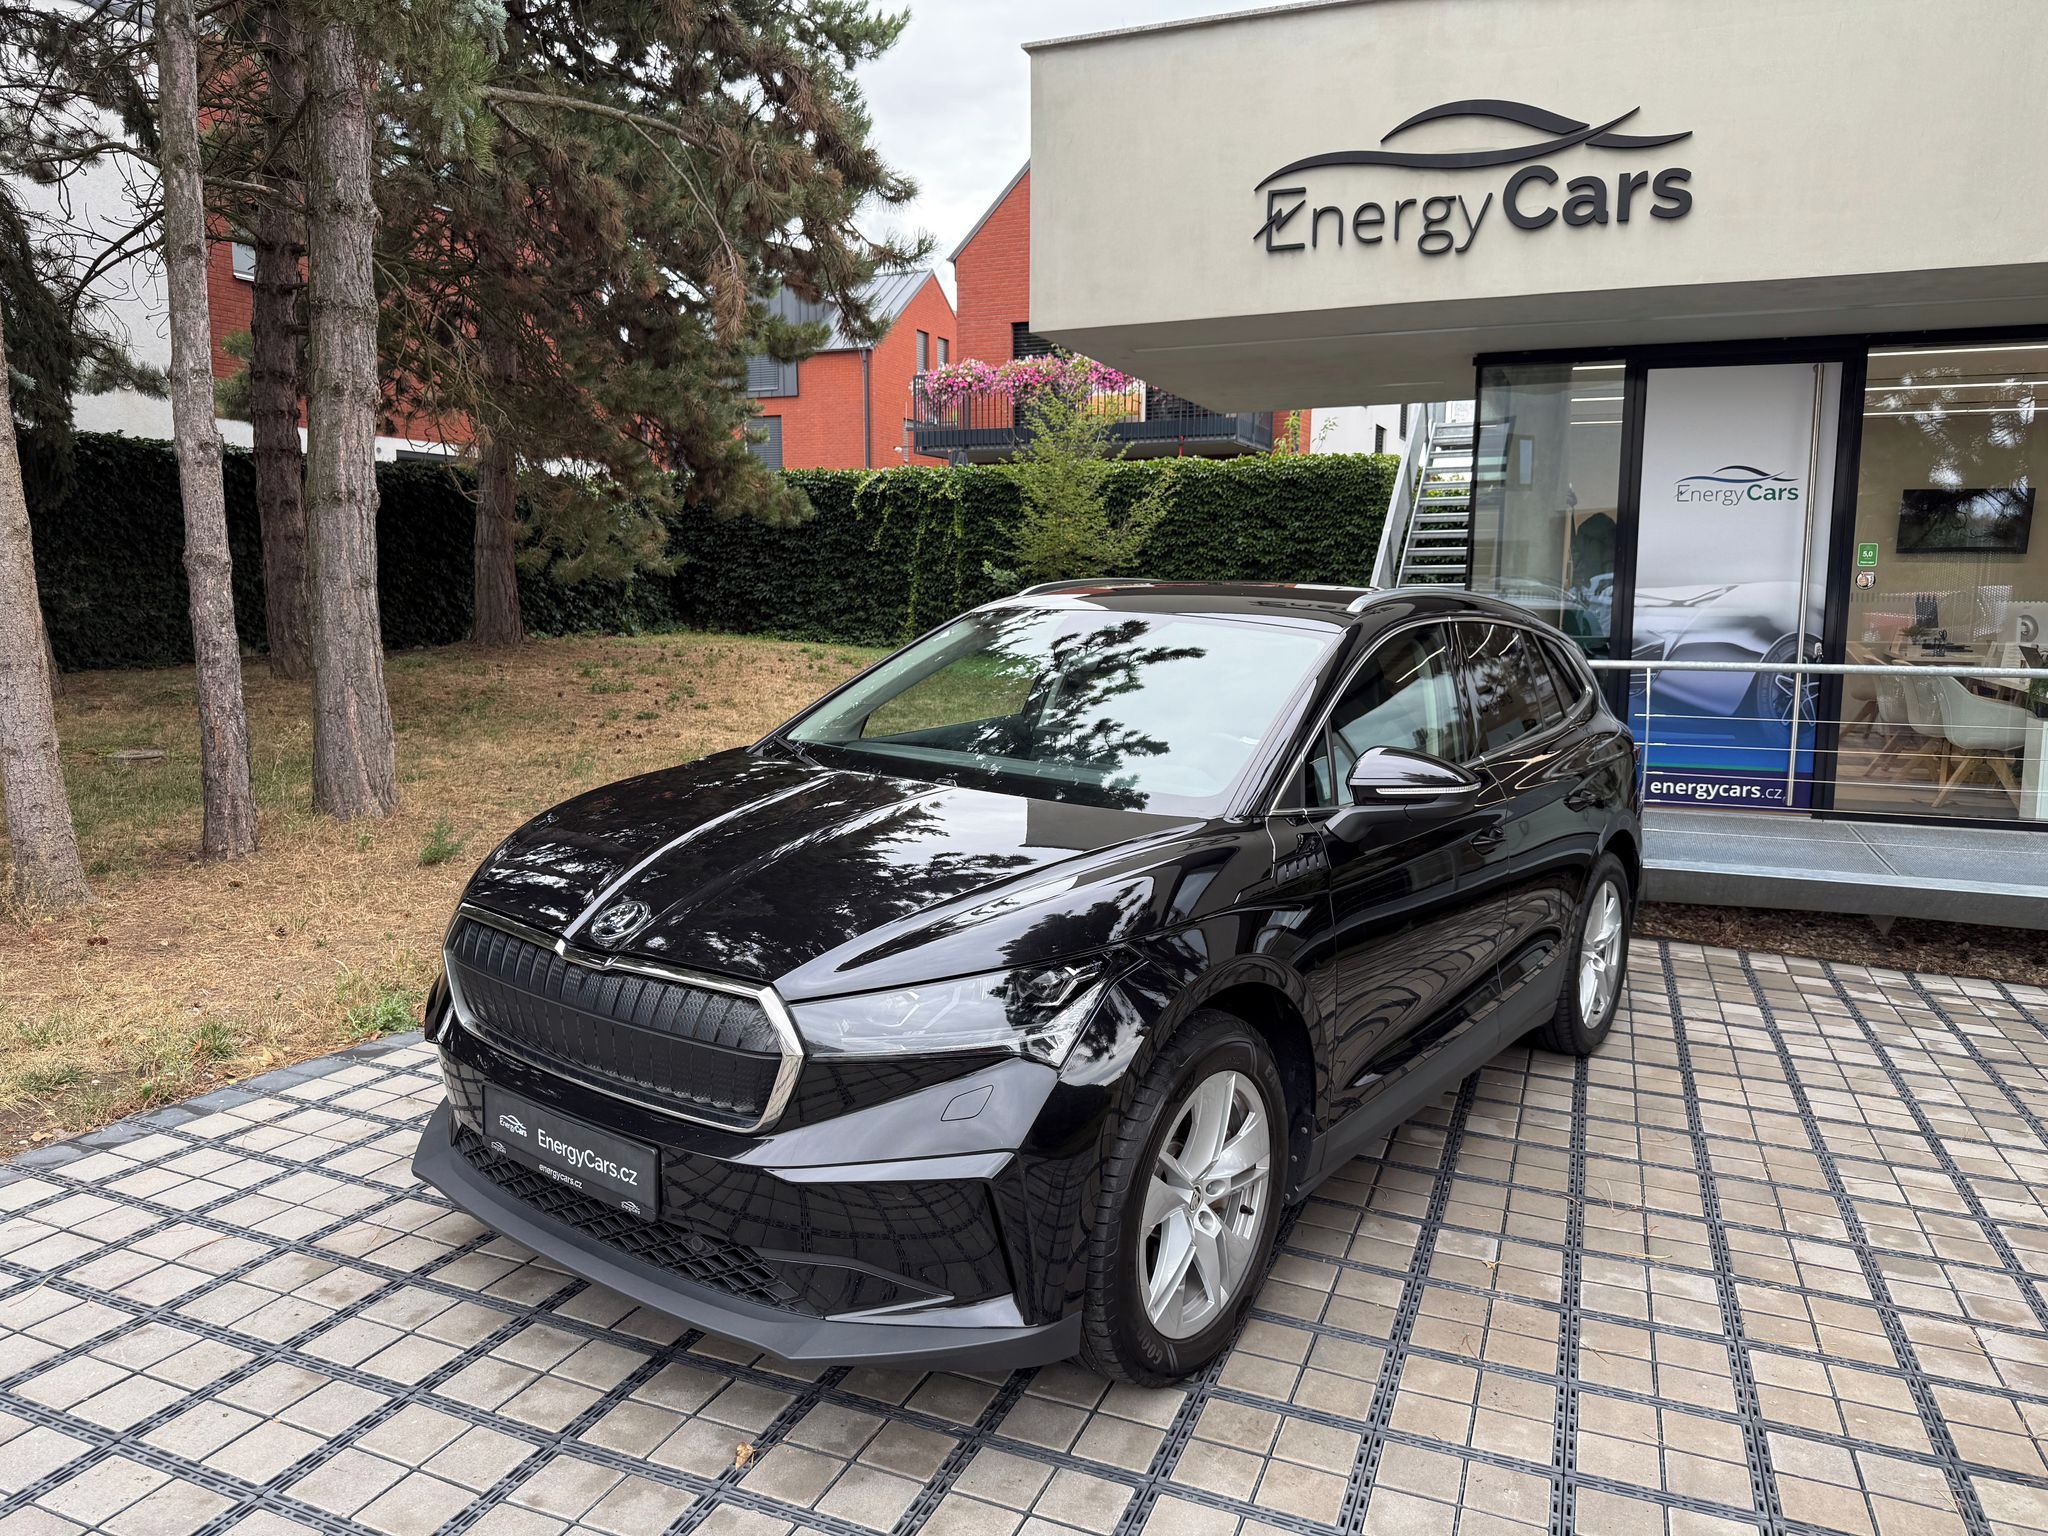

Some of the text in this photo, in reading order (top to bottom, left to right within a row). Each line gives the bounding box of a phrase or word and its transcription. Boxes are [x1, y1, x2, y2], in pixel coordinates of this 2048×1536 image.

[1254, 165, 1692, 255] EnergyCars
[1675, 484, 1799, 506] EnergyCars
[1650, 781, 1783, 799] energycars.cz
[538, 1128, 638, 1186] EnergyCars.cz
[539, 1164, 583, 1189] energycars.cz
